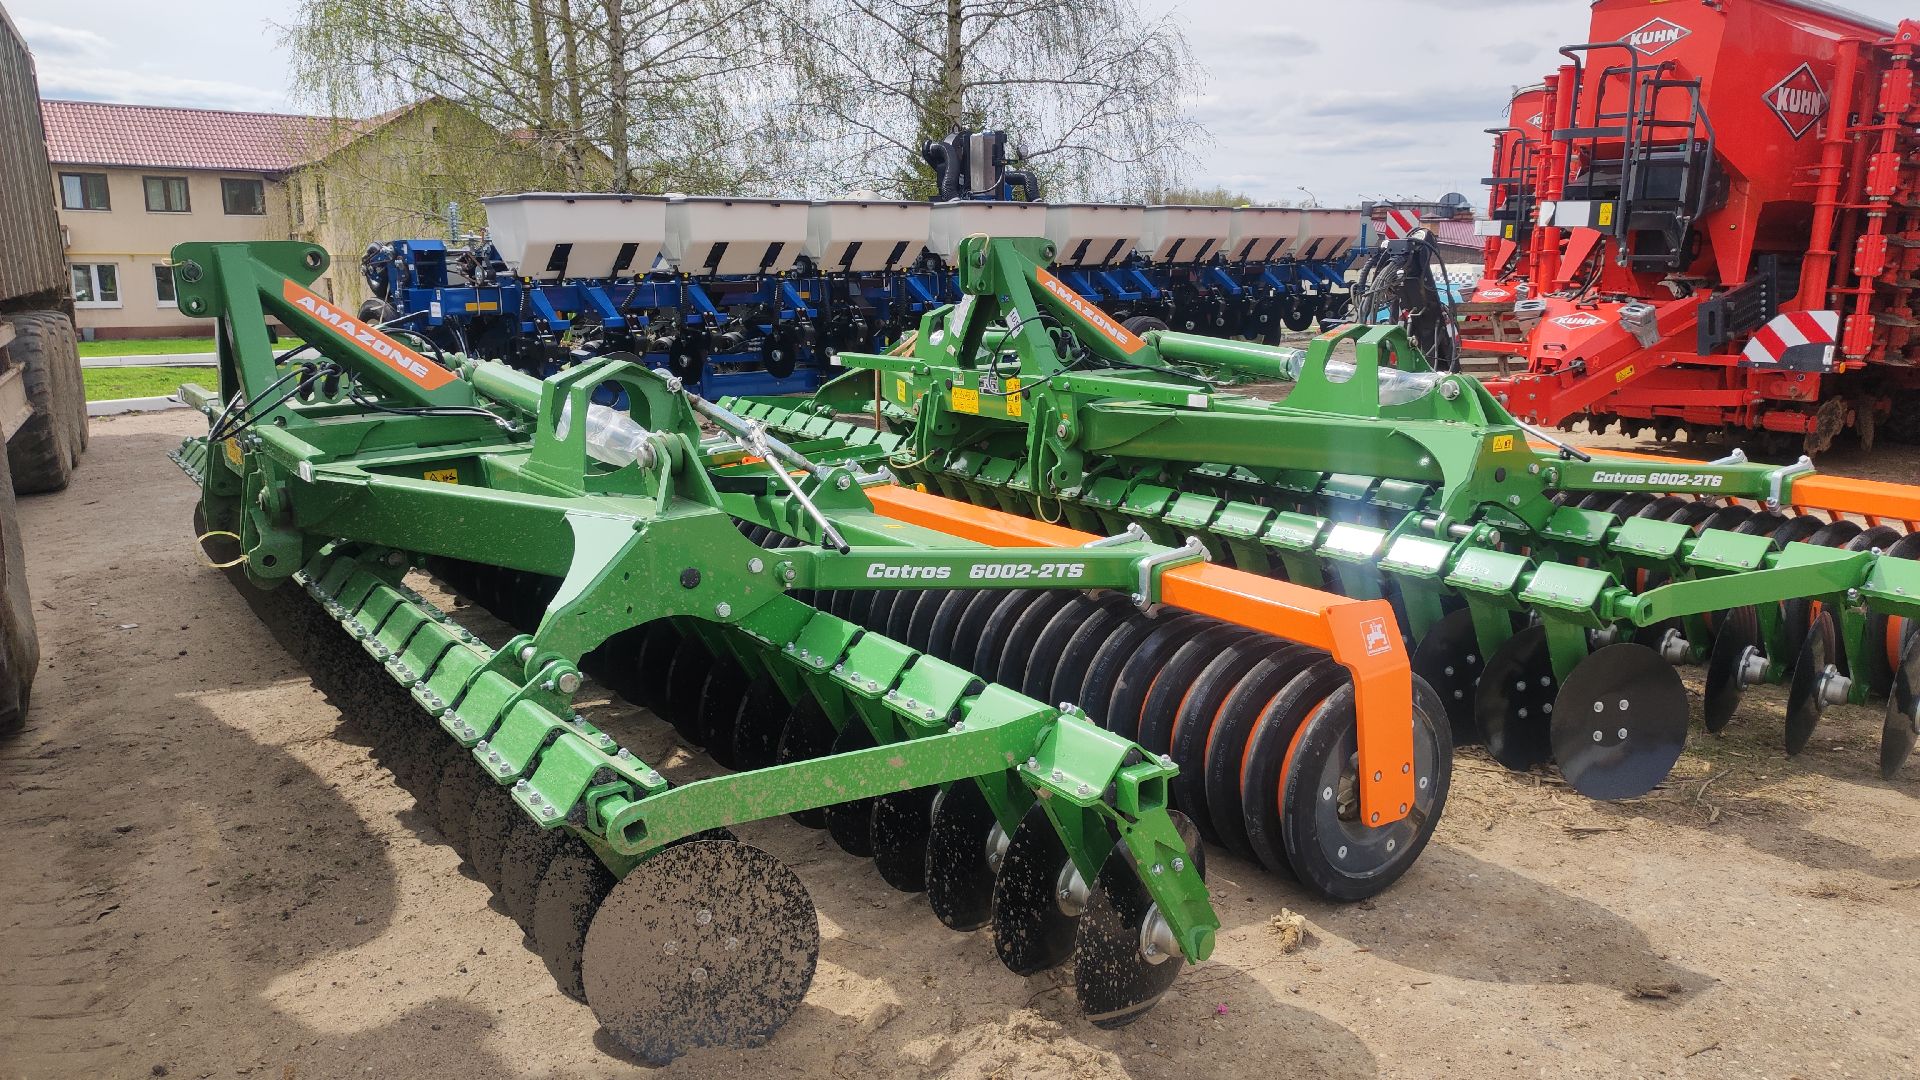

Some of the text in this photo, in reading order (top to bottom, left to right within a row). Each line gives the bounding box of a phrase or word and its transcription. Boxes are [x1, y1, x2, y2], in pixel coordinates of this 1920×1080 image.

[1629, 27, 1679, 45] KUHN
[1777, 86, 1821, 116] KUHN
[1045, 279, 1128, 344] AMAZONE
[1558, 317, 1598, 325] KUHN
[295, 296, 429, 379] AMAZONE
[1592, 471, 1646, 484] Catros
[866, 563, 1085, 579] Catros 6002-2TS
